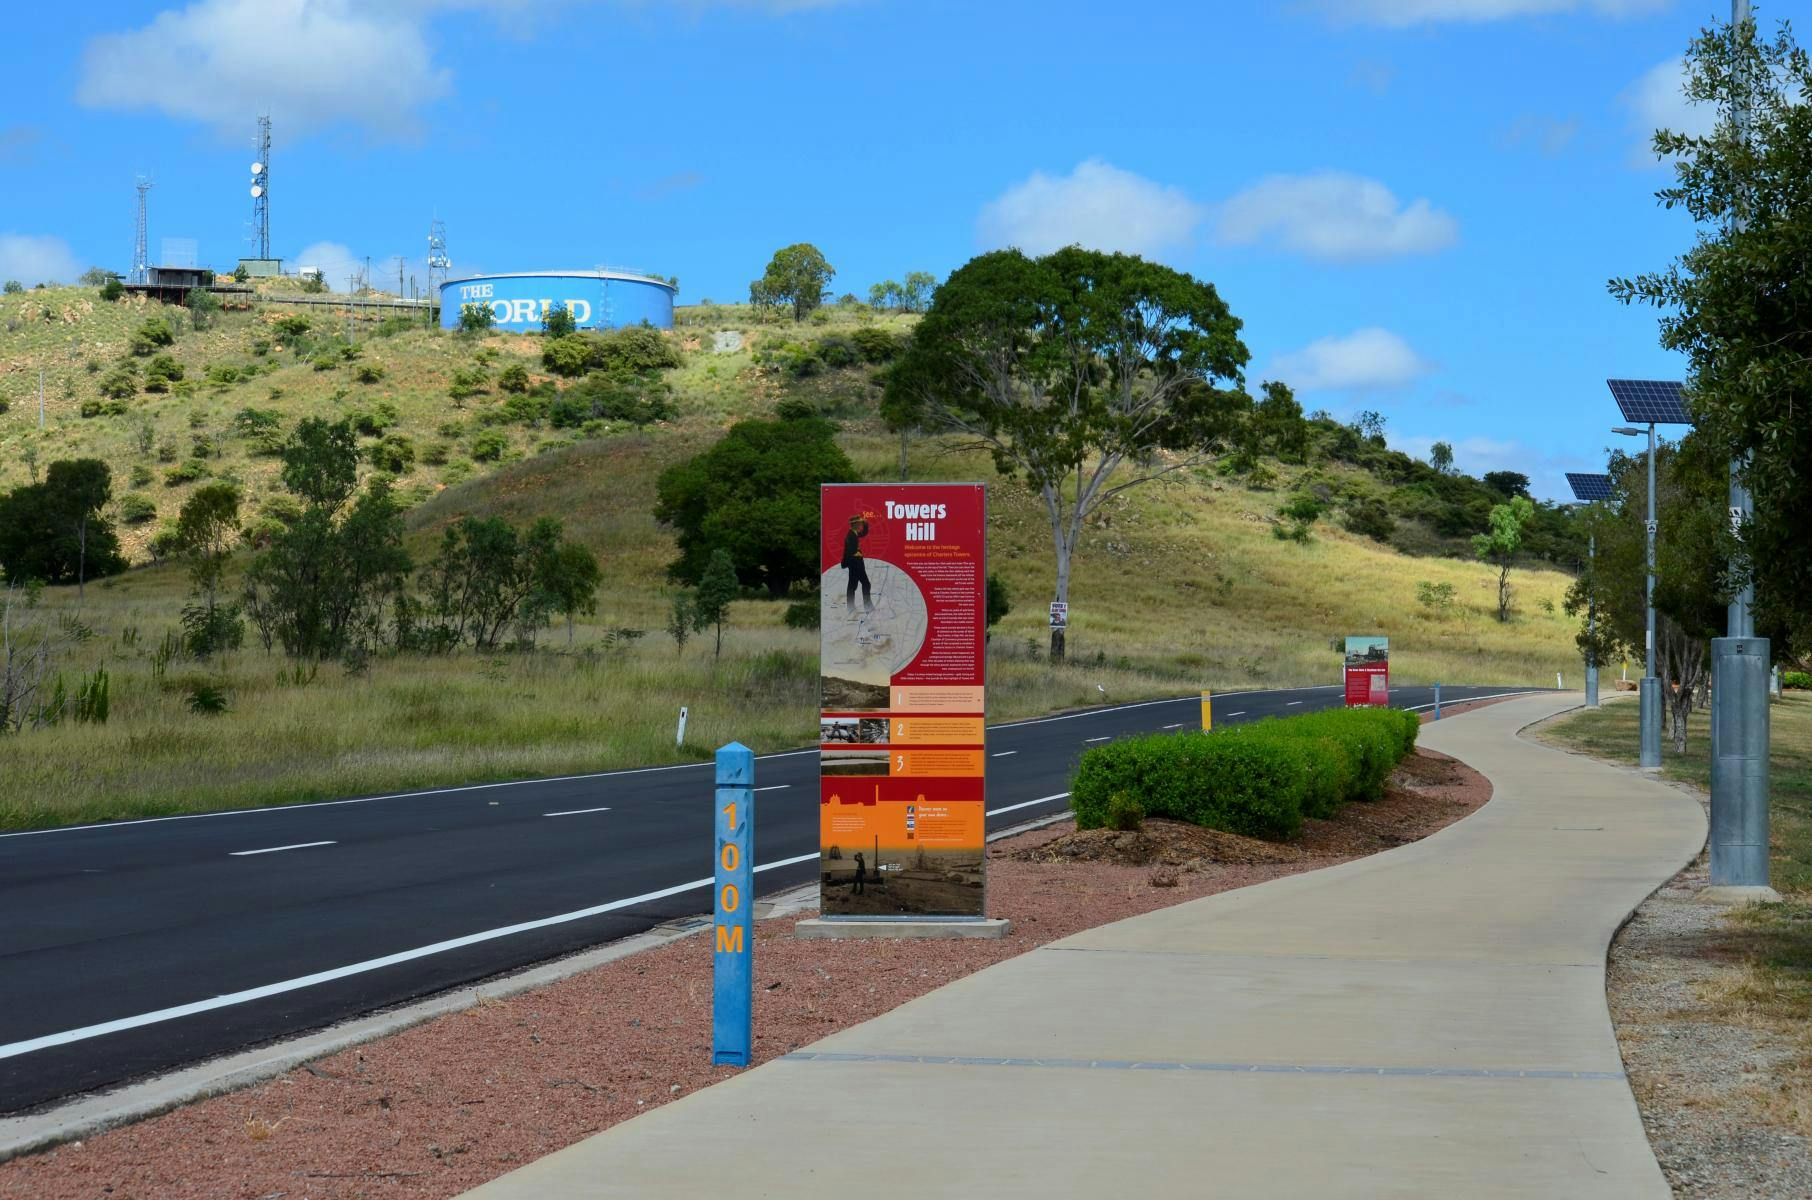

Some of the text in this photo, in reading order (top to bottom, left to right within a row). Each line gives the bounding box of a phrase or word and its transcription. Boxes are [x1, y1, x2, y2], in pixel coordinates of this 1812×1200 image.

[460, 284, 493, 299] THE
[460, 299, 591, 323] ORLD
[885, 501, 946, 519] Towers
[906, 523, 935, 541] Hill
[897, 723, 904, 736] 2
[897, 755, 904, 772] 3
